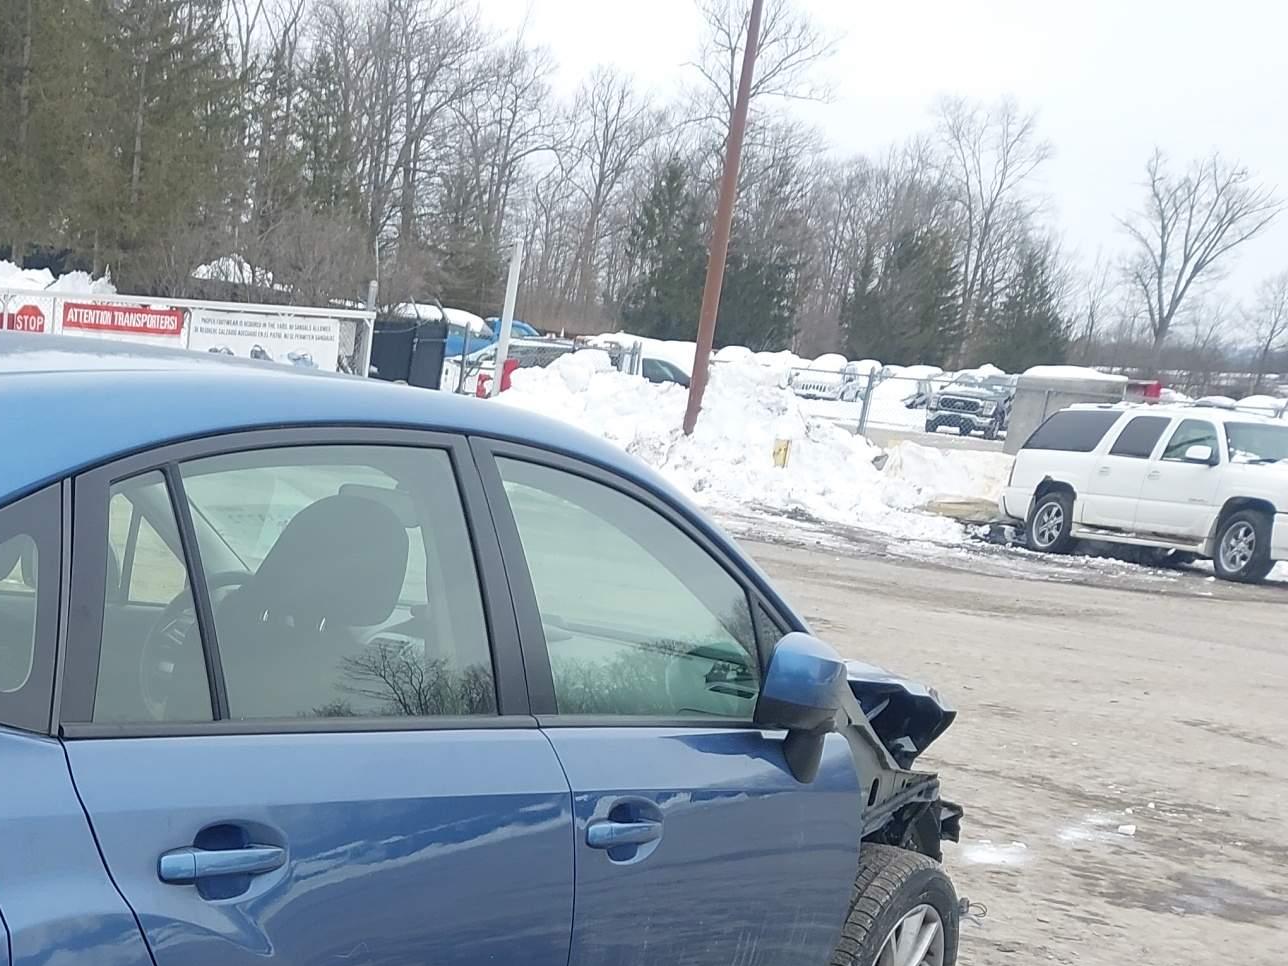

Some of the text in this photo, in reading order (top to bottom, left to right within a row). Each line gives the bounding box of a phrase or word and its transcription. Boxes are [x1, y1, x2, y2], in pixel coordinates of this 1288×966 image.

[16, 315, 44, 331] STOP
[66, 307, 178, 330] ATTENTION TRANSPORTERS!
